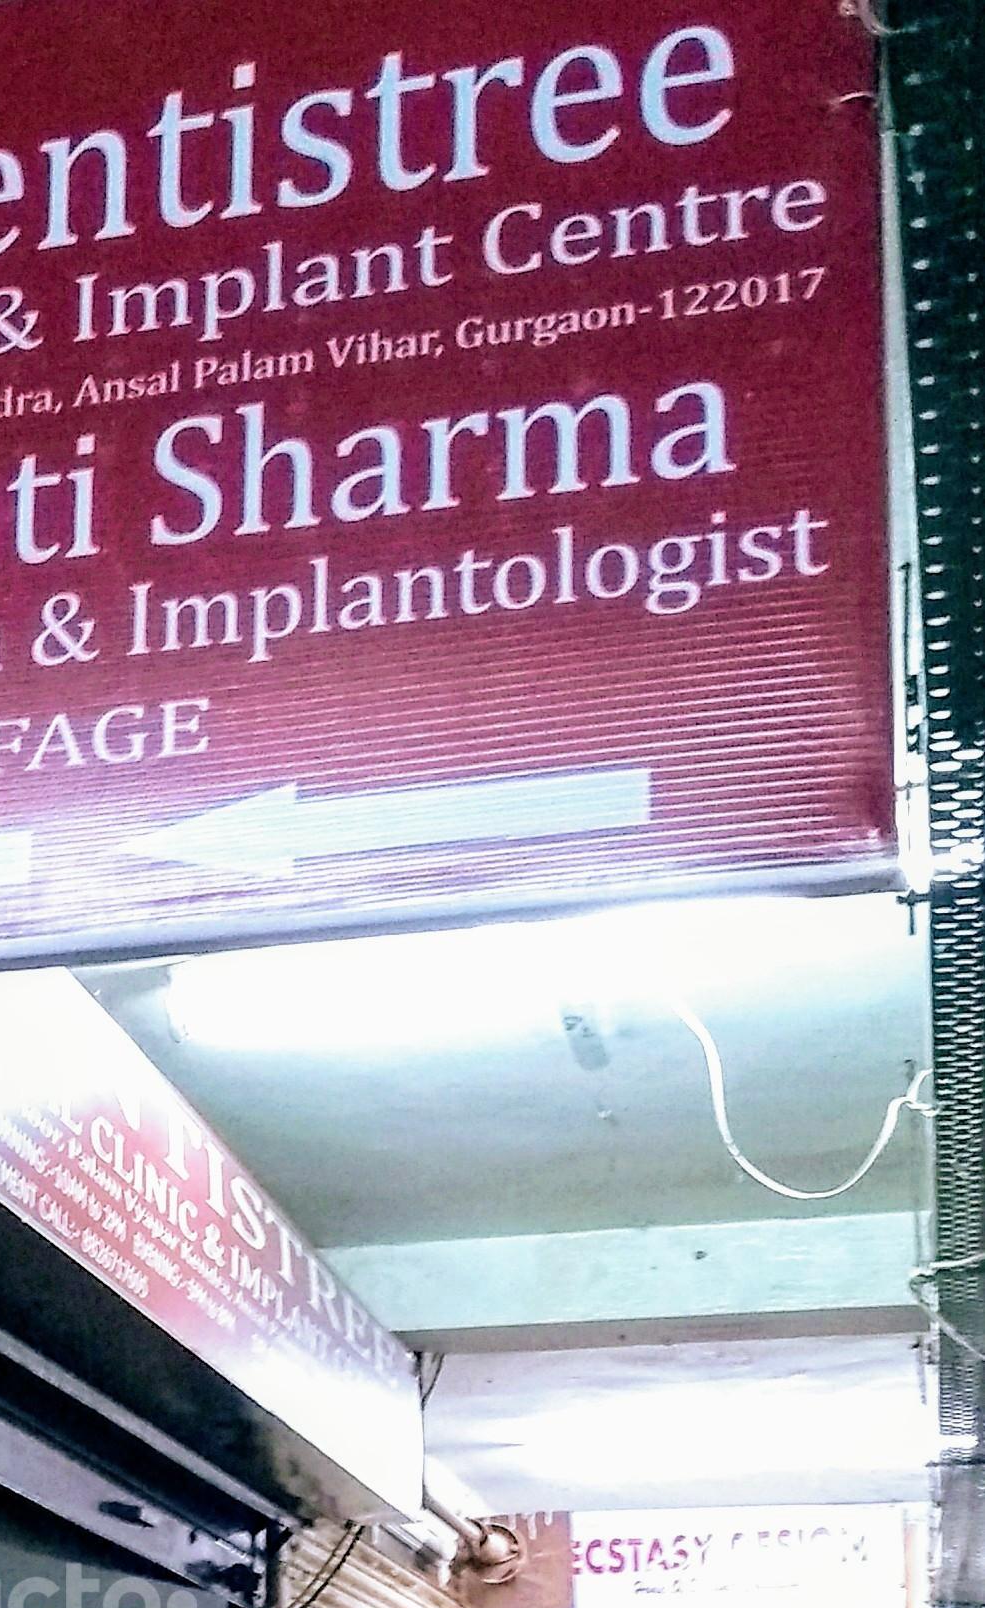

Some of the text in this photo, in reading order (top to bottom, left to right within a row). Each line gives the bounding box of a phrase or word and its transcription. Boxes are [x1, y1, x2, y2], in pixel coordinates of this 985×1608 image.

[72, 229, 455, 344] Implant
[482, 177, 828, 277] Centre
[73, 361, 181, 410] Ansal
[193, 348, 314, 390] Palam
[327, 326, 445, 370] Vihar,
[456, 266, 827, 352] Gurgaon-122017
[151, 379, 734, 551] Sharma
[31, 592, 98, 668] &
[128, 508, 829, 664] Implantologist
[90, 1115, 199, 1243] CLINIC
[202, 1222, 226, 1268] &
